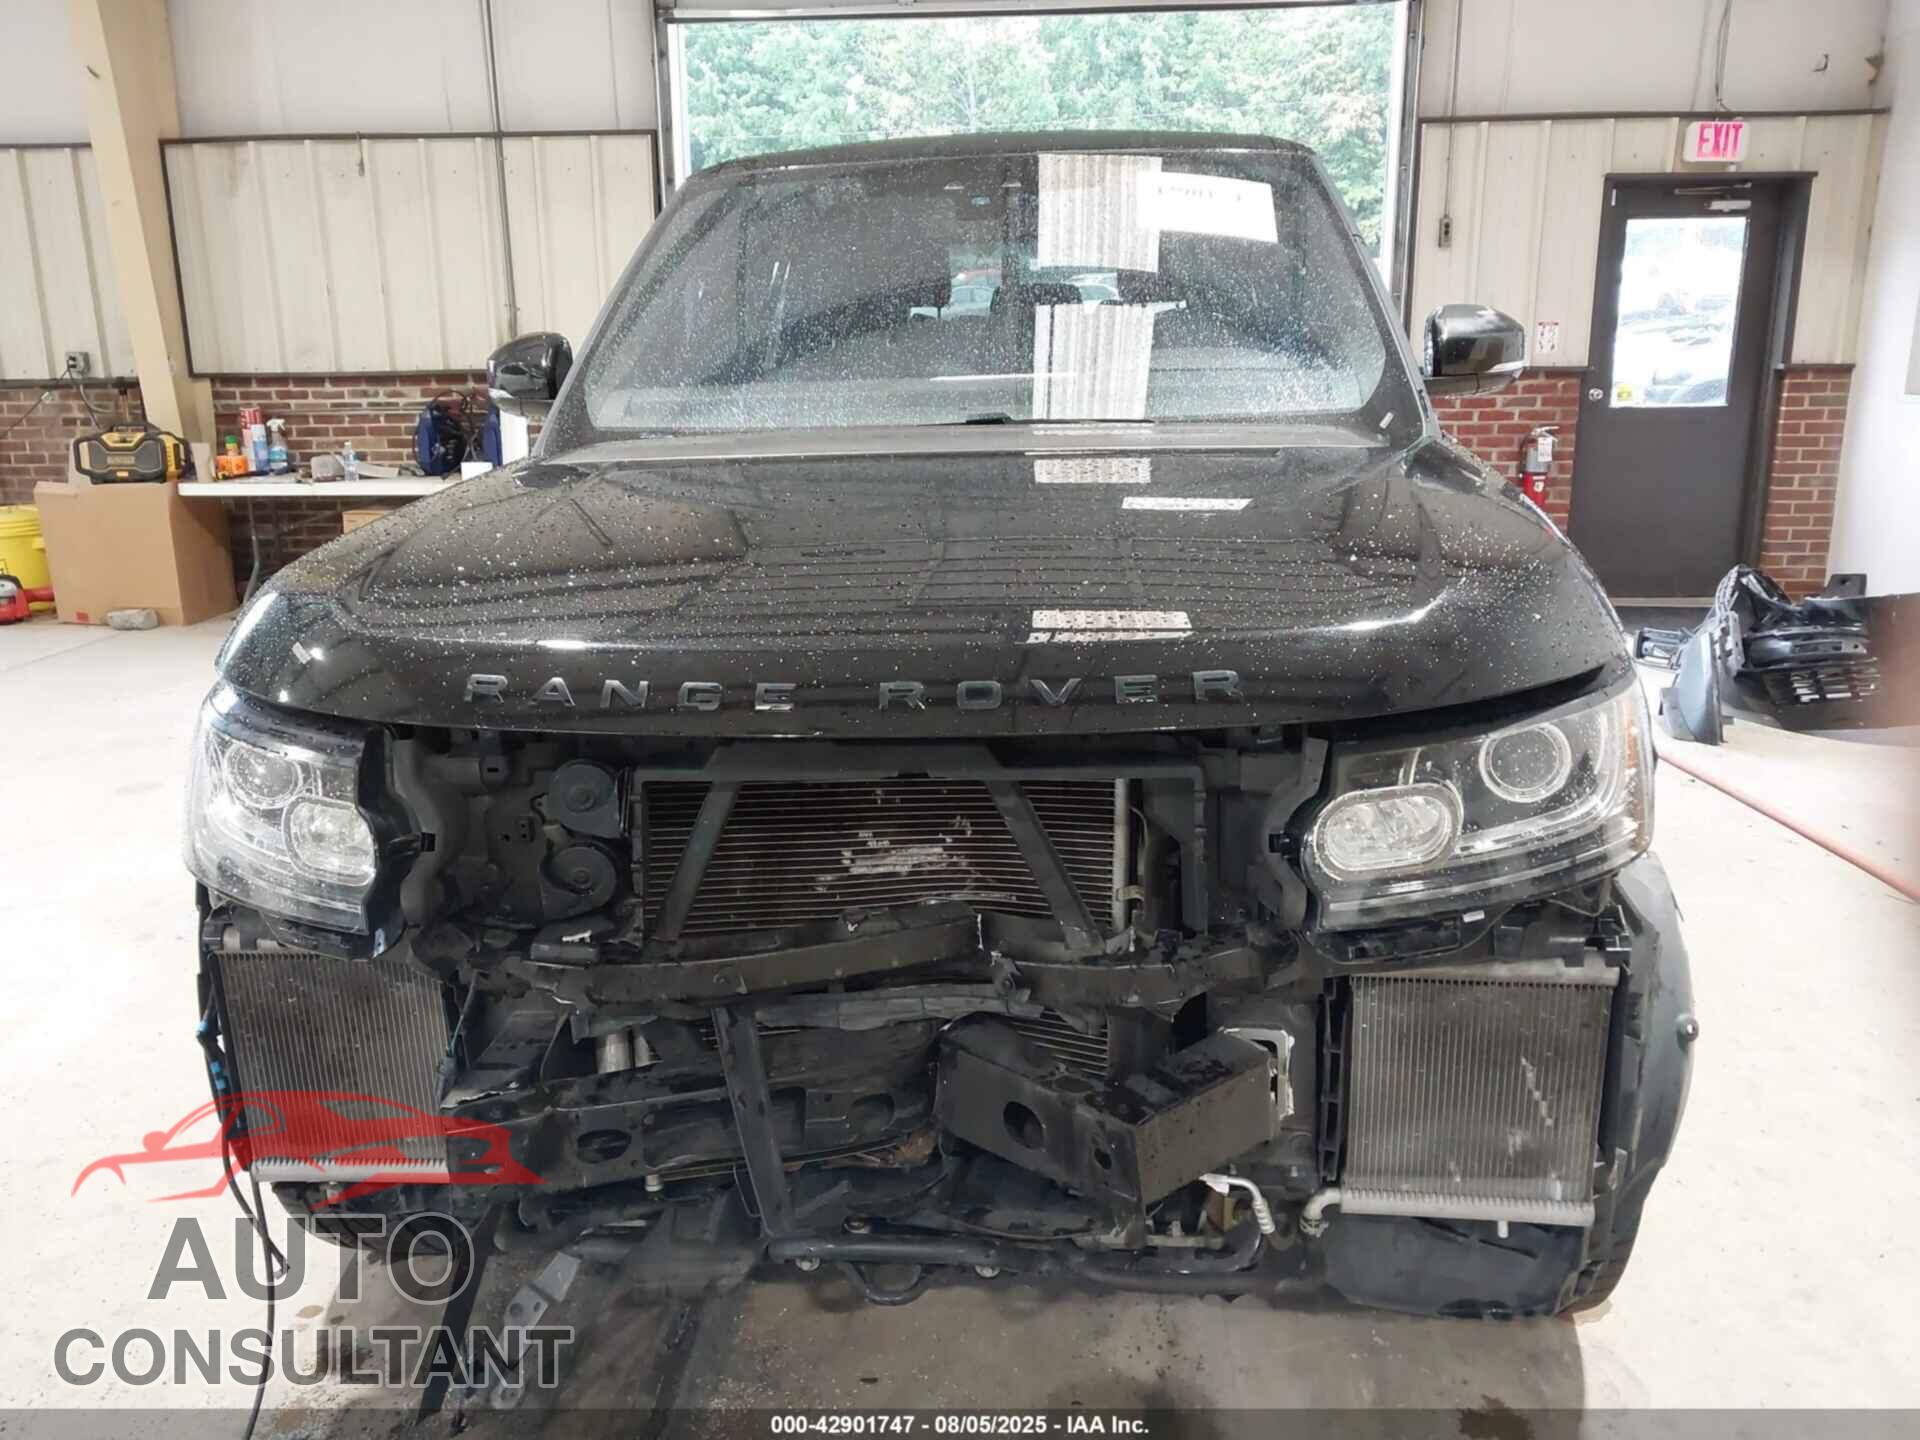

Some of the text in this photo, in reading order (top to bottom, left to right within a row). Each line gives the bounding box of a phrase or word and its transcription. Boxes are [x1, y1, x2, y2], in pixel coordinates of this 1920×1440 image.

[1697, 123, 1743, 158] EXIT
[464, 670, 1243, 711] RANGE ROVER
